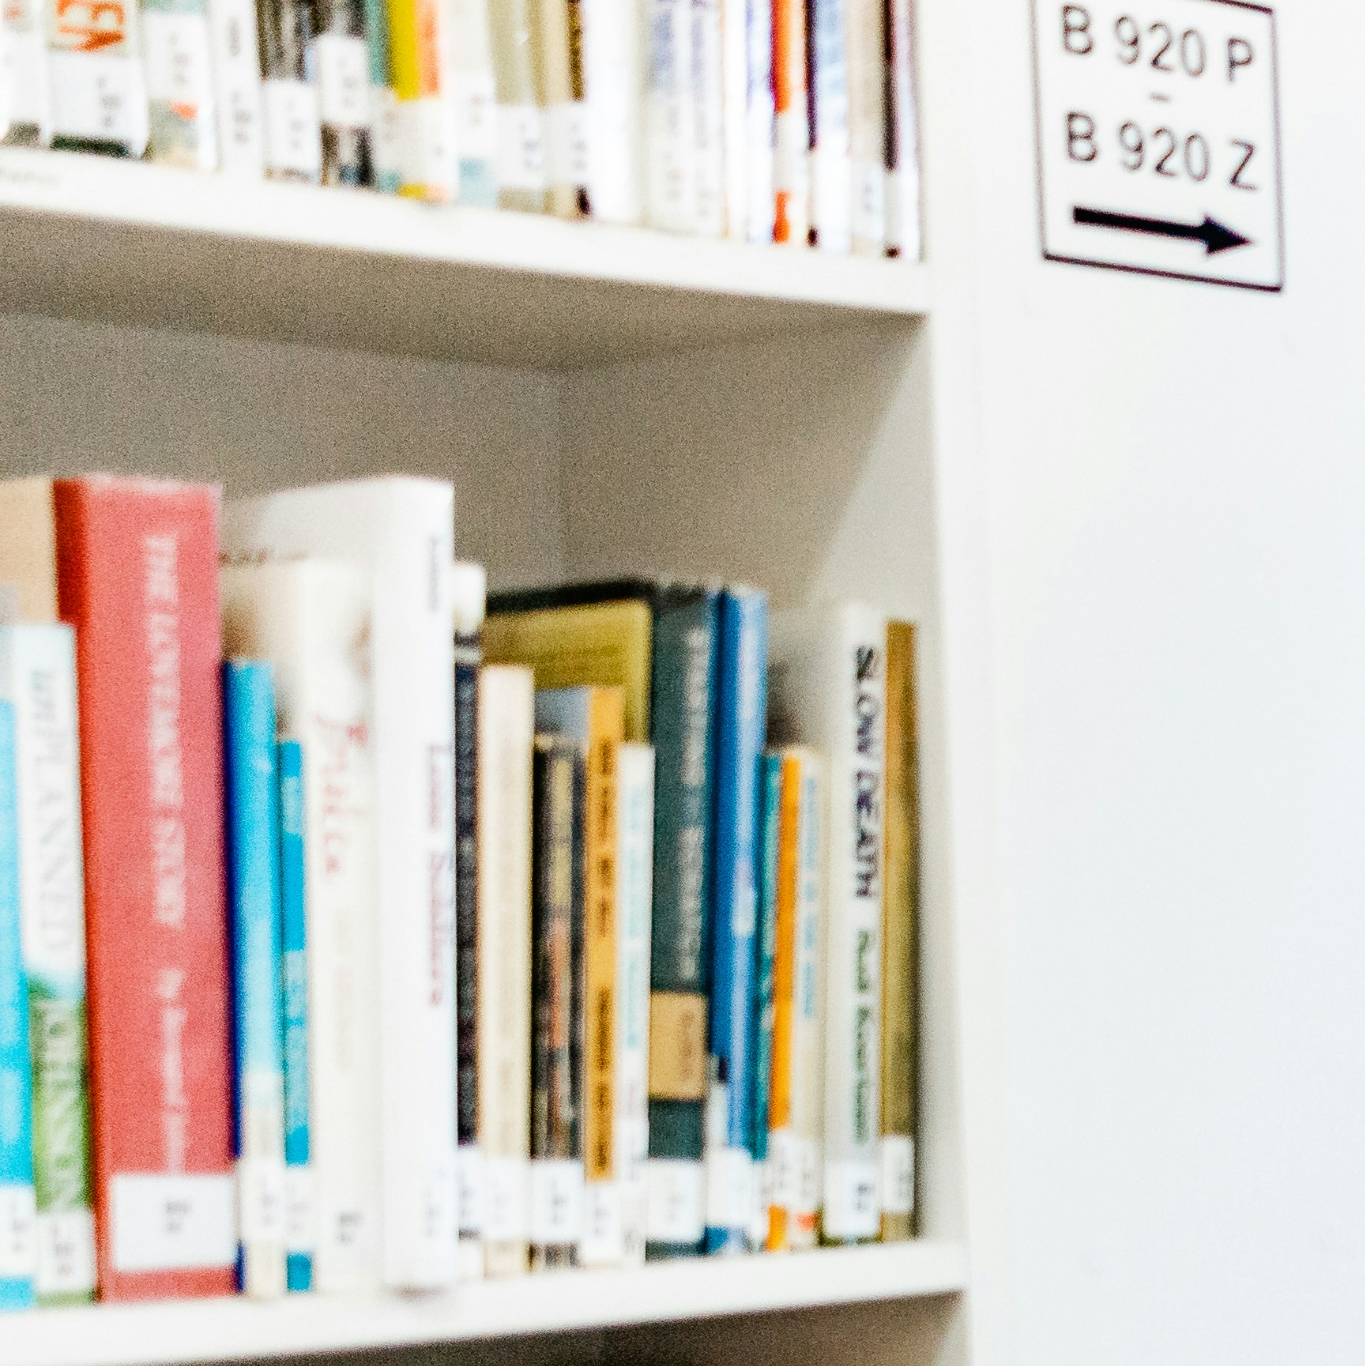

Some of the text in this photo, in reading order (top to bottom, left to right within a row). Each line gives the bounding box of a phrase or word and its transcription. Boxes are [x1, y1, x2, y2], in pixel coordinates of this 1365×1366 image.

[1062, 5, 1254, 83] B 920 P
[1067, 112, 1257, 191] B 920 Z
[853, 646, 881, 898] SLOW DEATH
